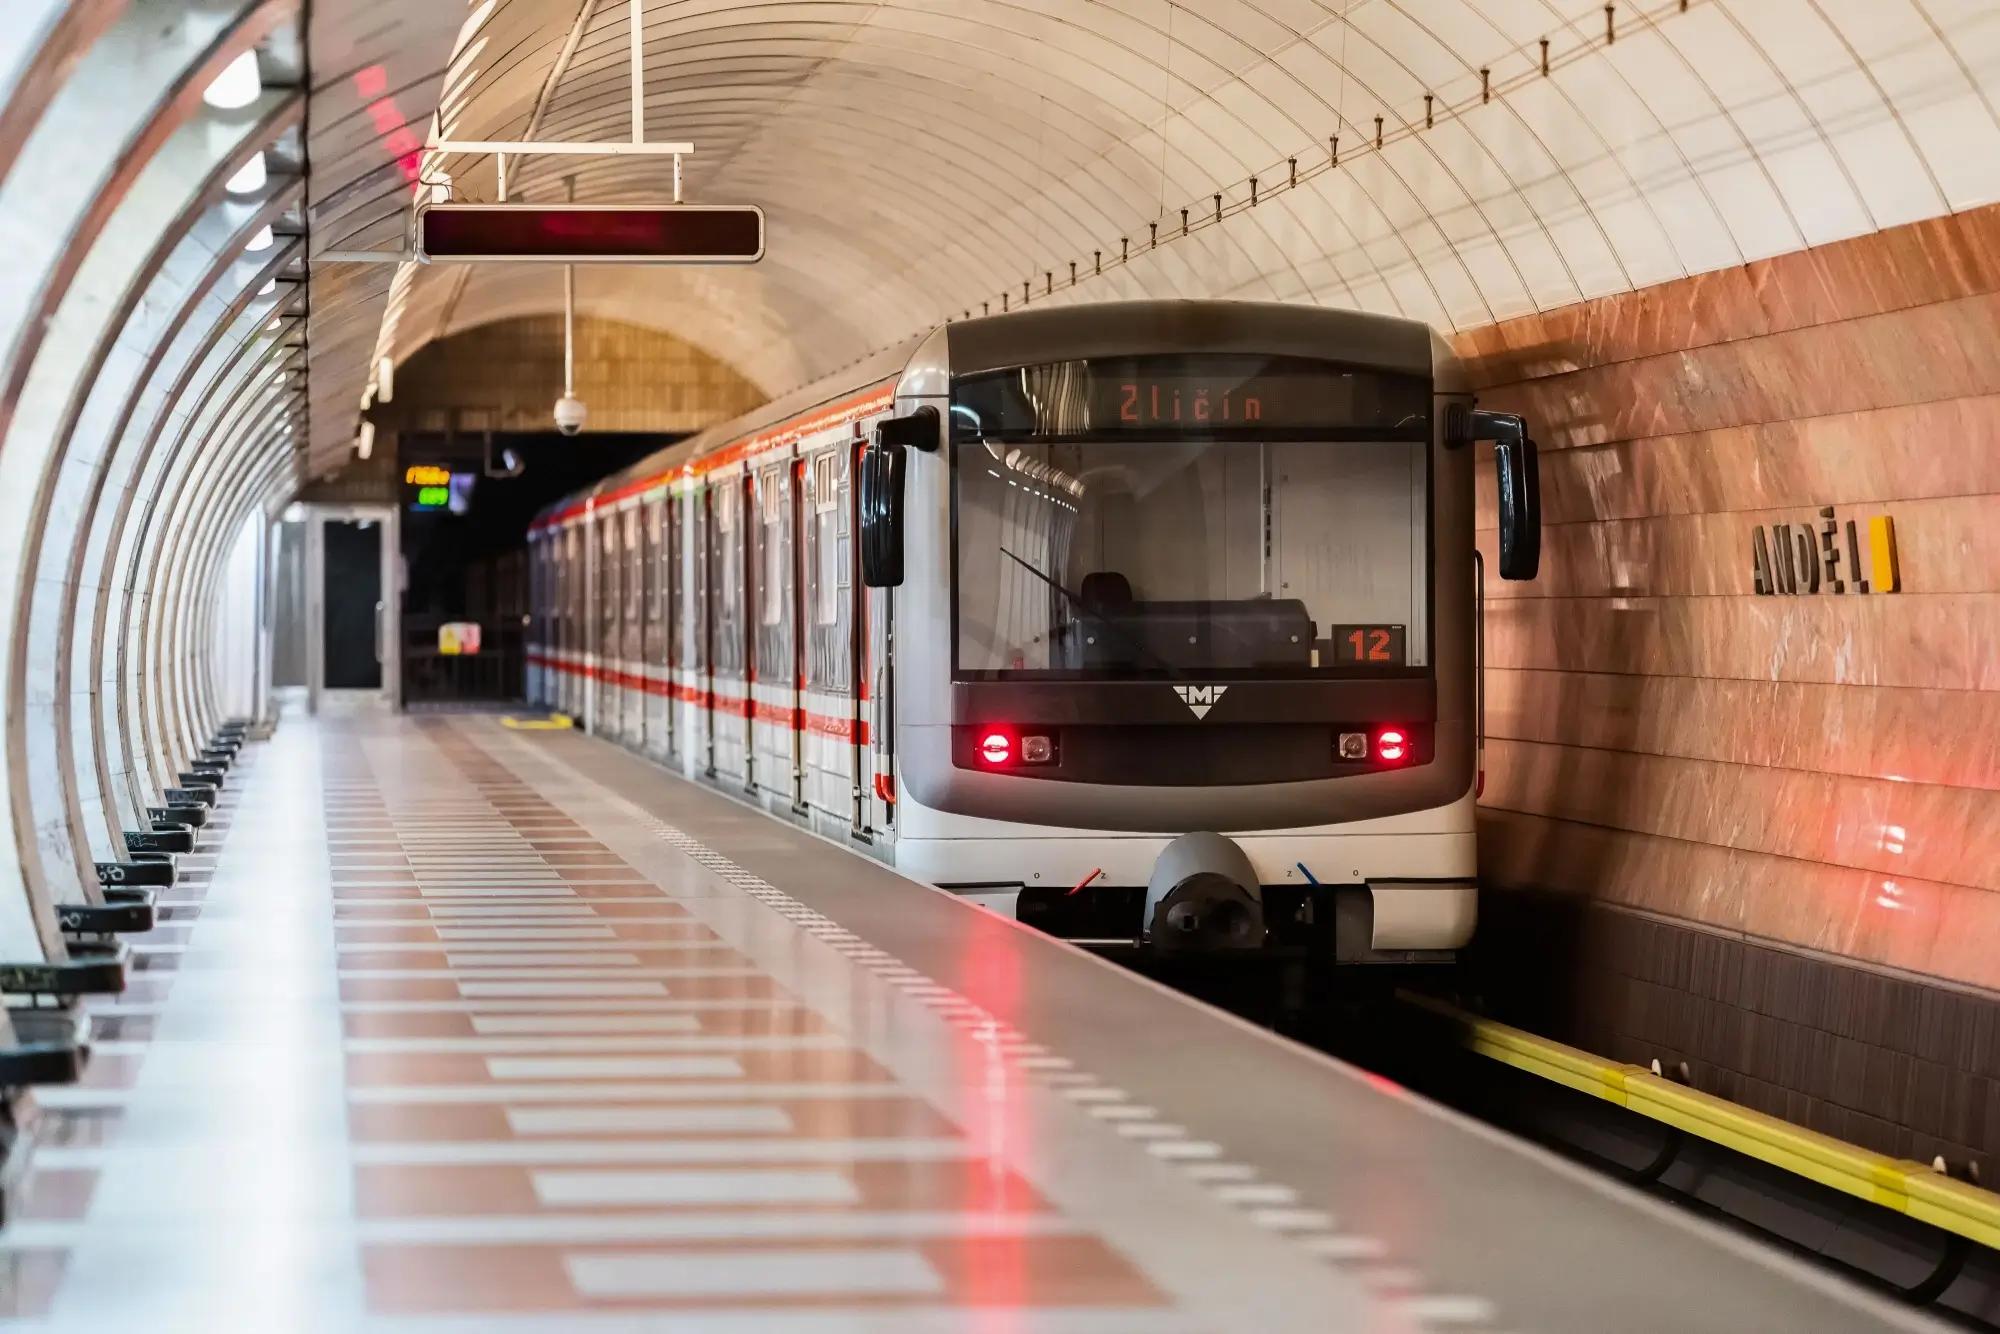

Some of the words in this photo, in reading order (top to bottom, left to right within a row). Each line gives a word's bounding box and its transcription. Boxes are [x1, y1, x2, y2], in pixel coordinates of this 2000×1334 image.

[1120, 384, 1261, 421] Zličín
[1752, 506, 1869, 595] ANDĚL
[1348, 629, 1391, 660] 12
